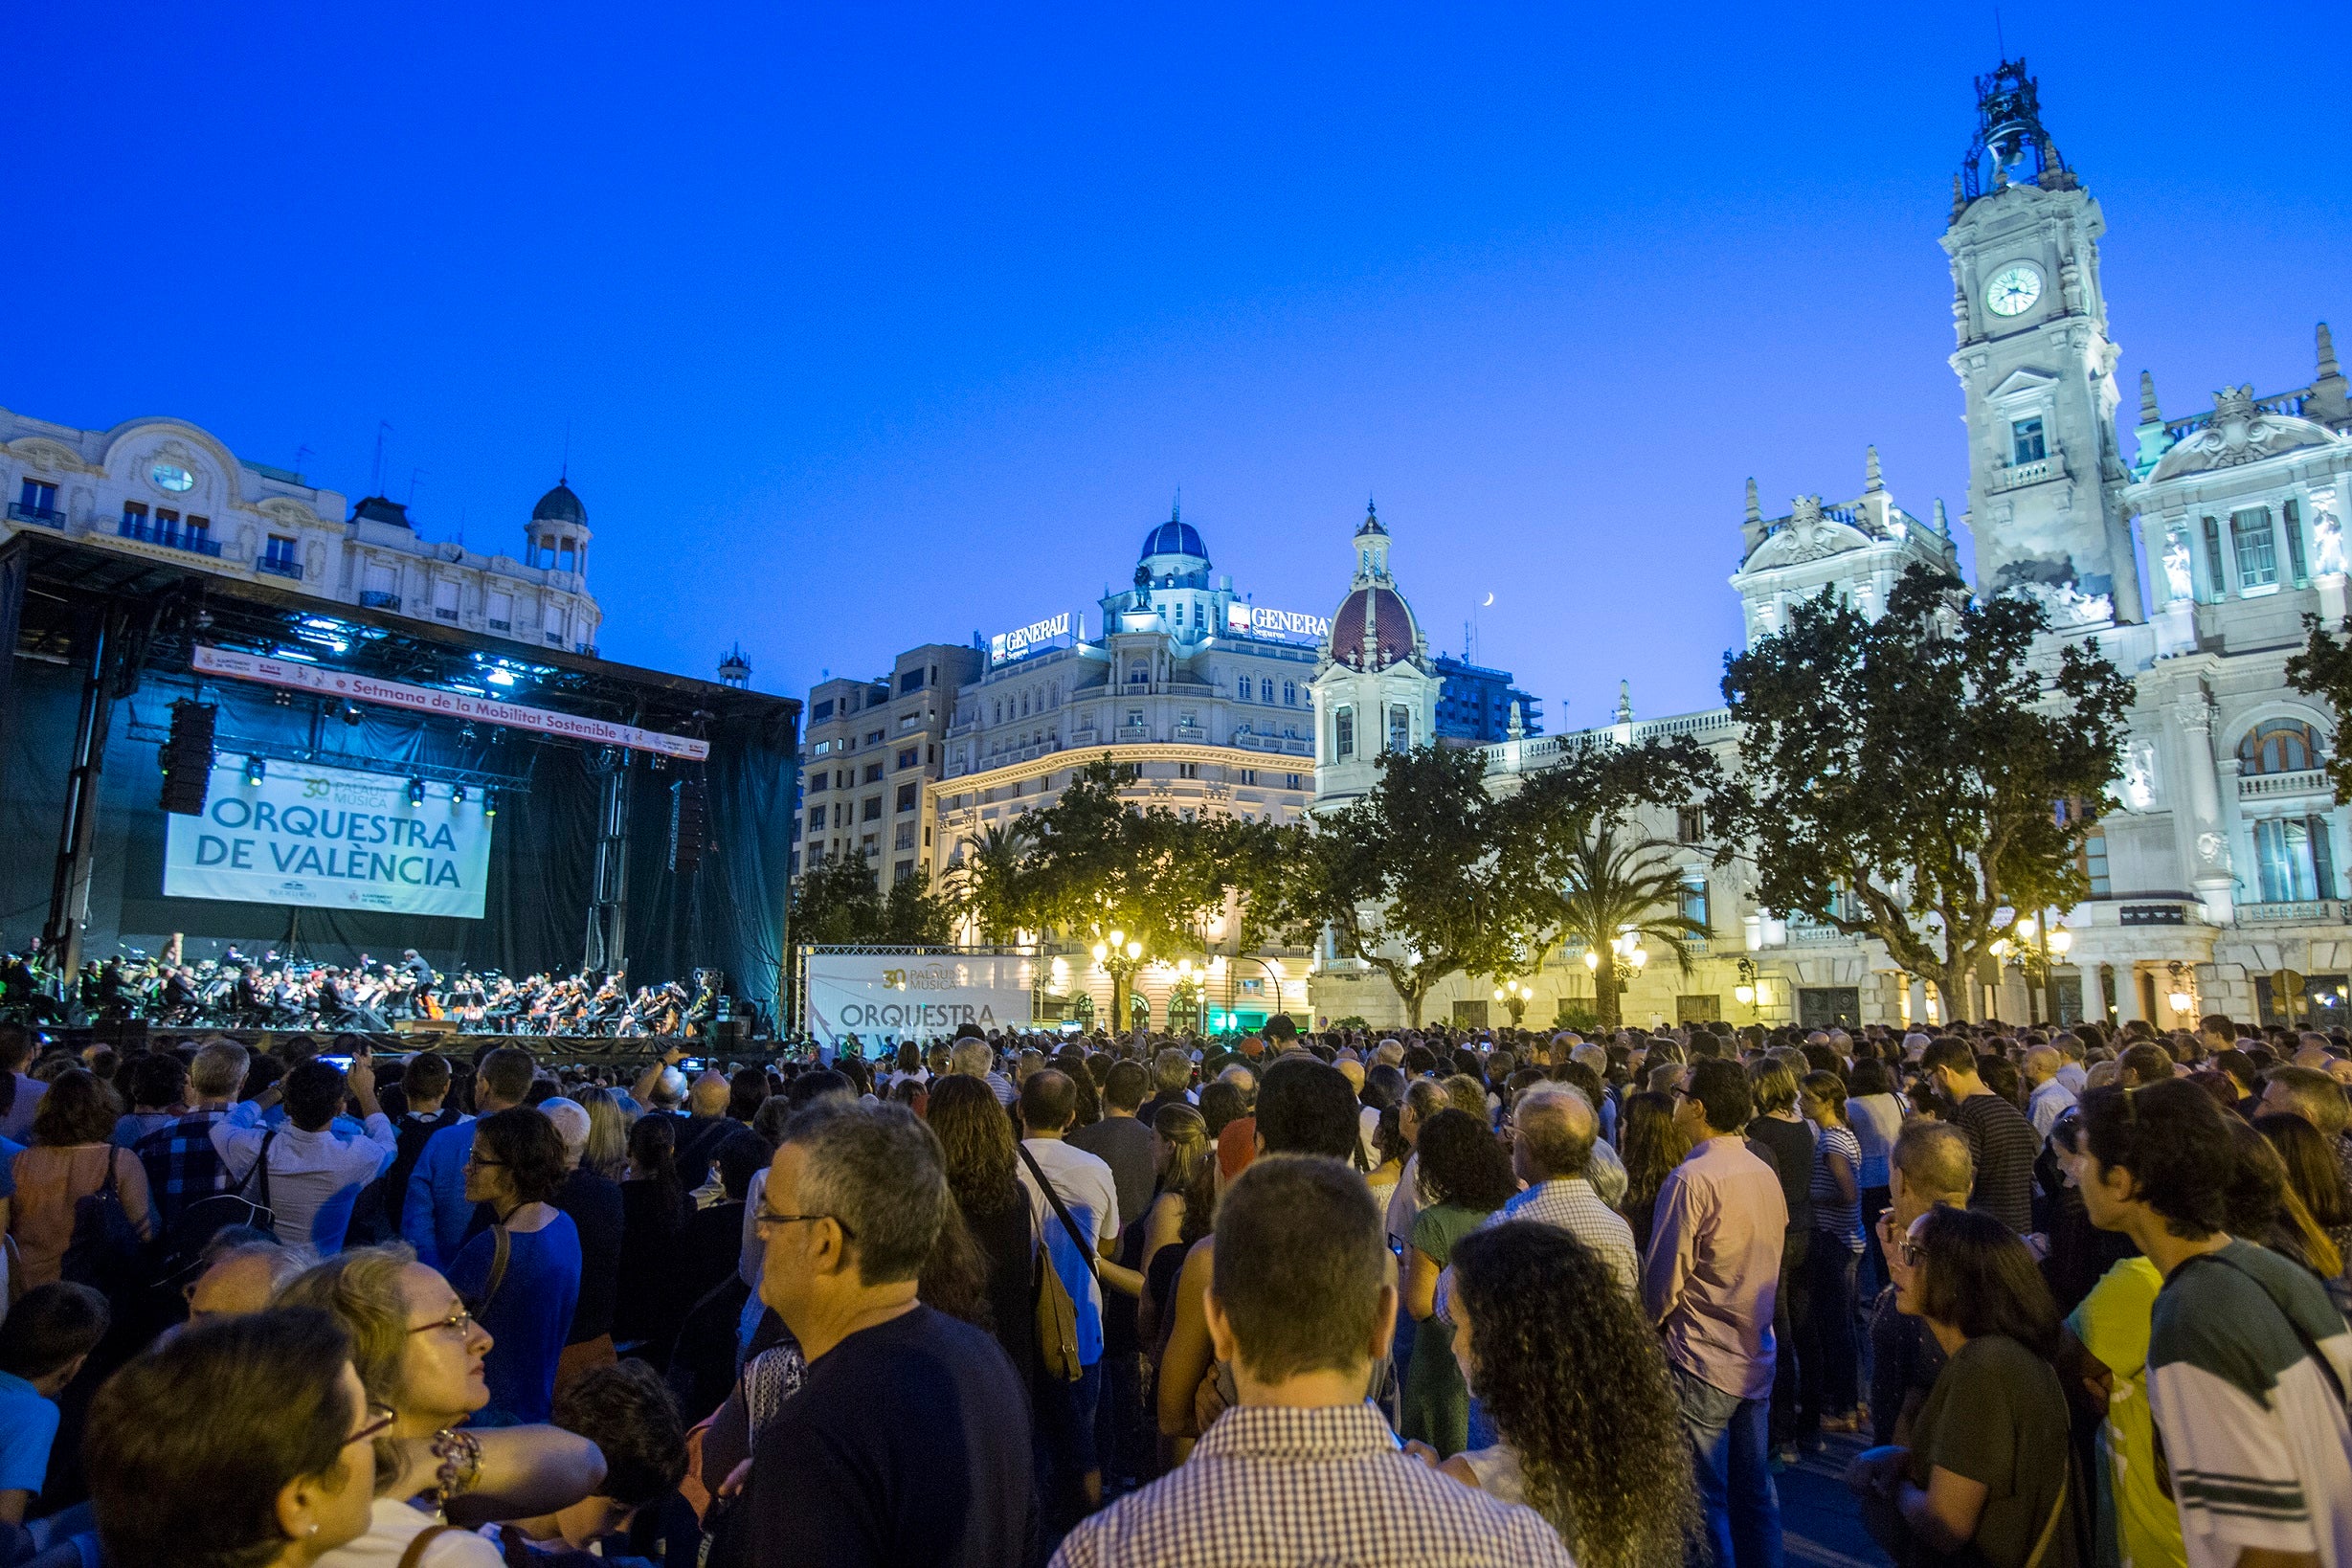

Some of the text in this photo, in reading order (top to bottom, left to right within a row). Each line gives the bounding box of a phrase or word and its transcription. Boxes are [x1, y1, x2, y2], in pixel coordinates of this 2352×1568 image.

[1006, 612, 1069, 651] GENERALI
[1251, 607, 1332, 638] GENERA
[1252, 625, 1286, 638] Seguros
[352, 681, 616, 739] Setmana de la Mobilitat Sostenible
[302, 777, 330, 798] 30
[335, 781, 379, 796] PALAU
[212, 796, 457, 852] ORQUESTRA
[195, 835, 461, 888] DE VALÈNCIA
[883, 968, 907, 989] 30
[910, 969, 949, 980] PALAU
[840, 1003, 997, 1028] ORQUESTRA
